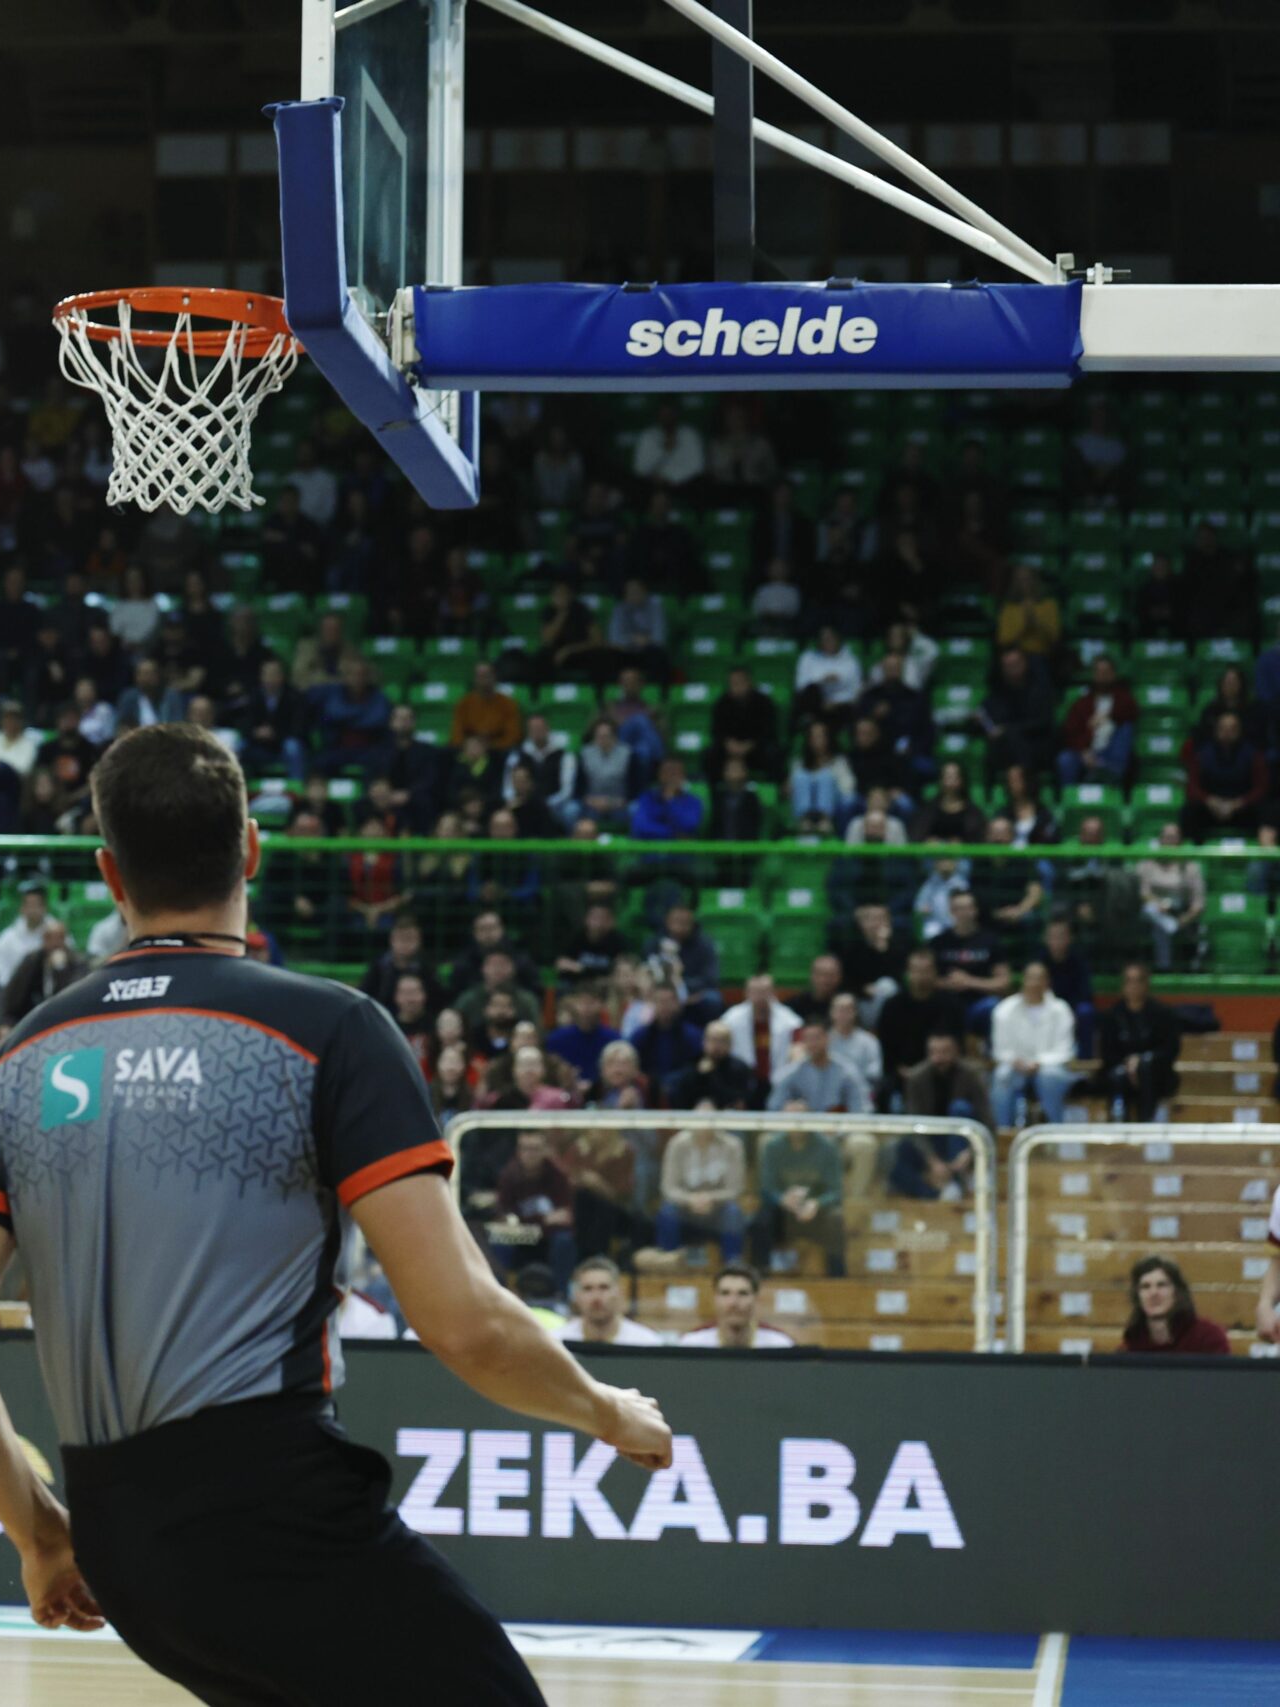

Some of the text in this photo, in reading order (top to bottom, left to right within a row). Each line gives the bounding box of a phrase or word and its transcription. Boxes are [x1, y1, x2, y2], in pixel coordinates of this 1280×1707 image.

[625, 305, 879, 357] schelde
[115, 1047, 202, 1085] SAVA
[396, 1427, 966, 1549] ZEKA.BA
